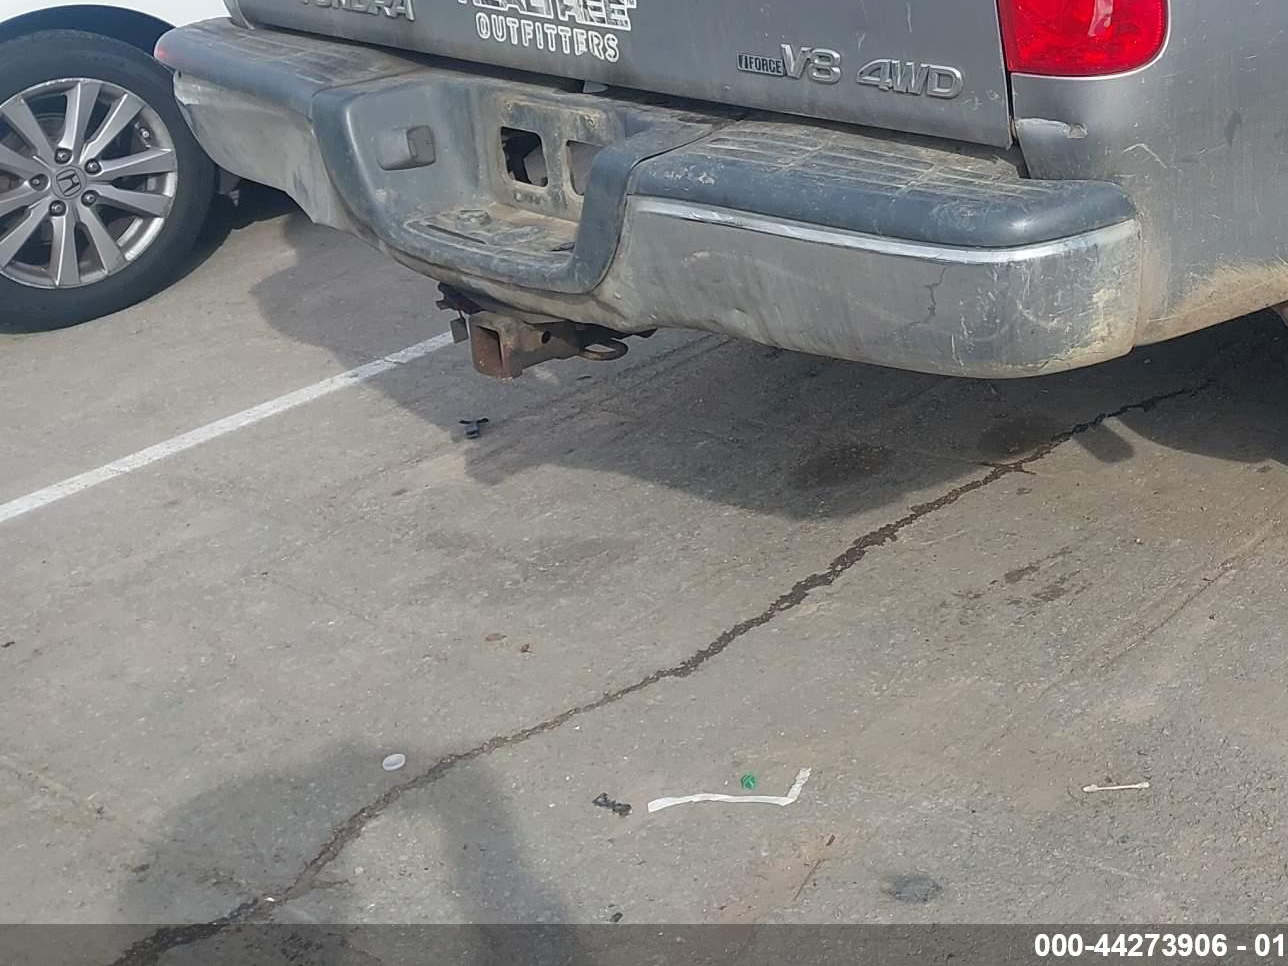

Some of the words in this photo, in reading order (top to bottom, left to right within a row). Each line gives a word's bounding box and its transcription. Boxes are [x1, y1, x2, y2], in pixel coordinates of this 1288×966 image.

[475, 12, 619, 63] OUTFITTERS
[780, 43, 842, 84] V8
[856, 58, 963, 99] 4WD
